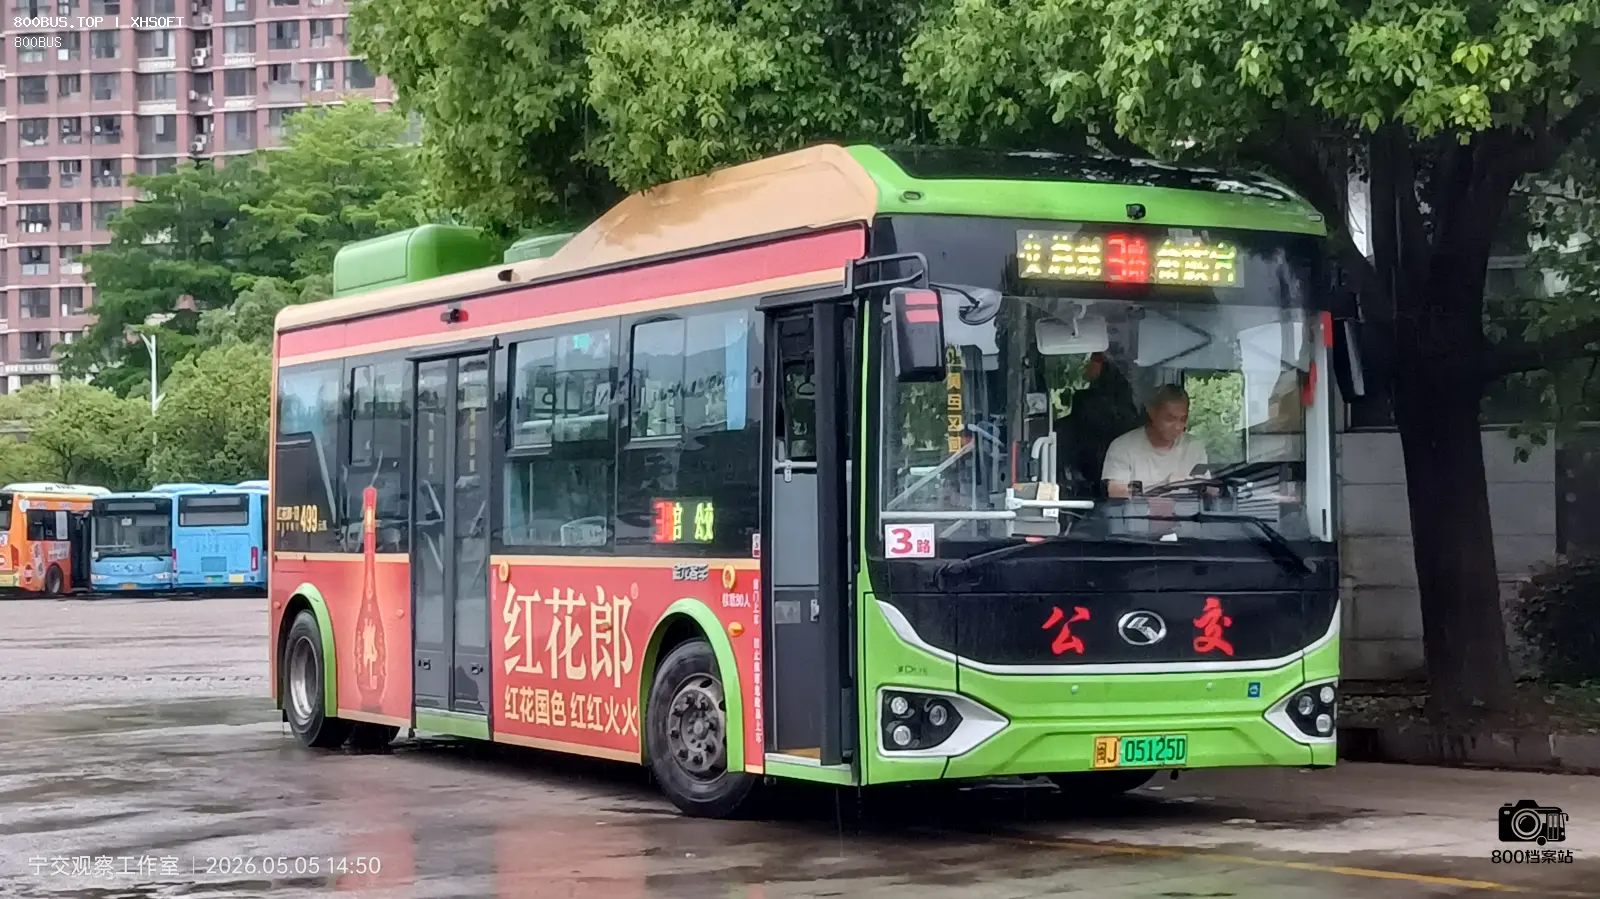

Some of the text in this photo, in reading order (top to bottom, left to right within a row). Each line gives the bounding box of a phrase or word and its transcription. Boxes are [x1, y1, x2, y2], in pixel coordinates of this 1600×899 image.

[890, 528, 931, 554] 3路
[503, 582, 633, 688] 红花郎
[1041, 596, 1235, 656] 公 交
[504, 684, 638, 737] 红花国色 红红火火
